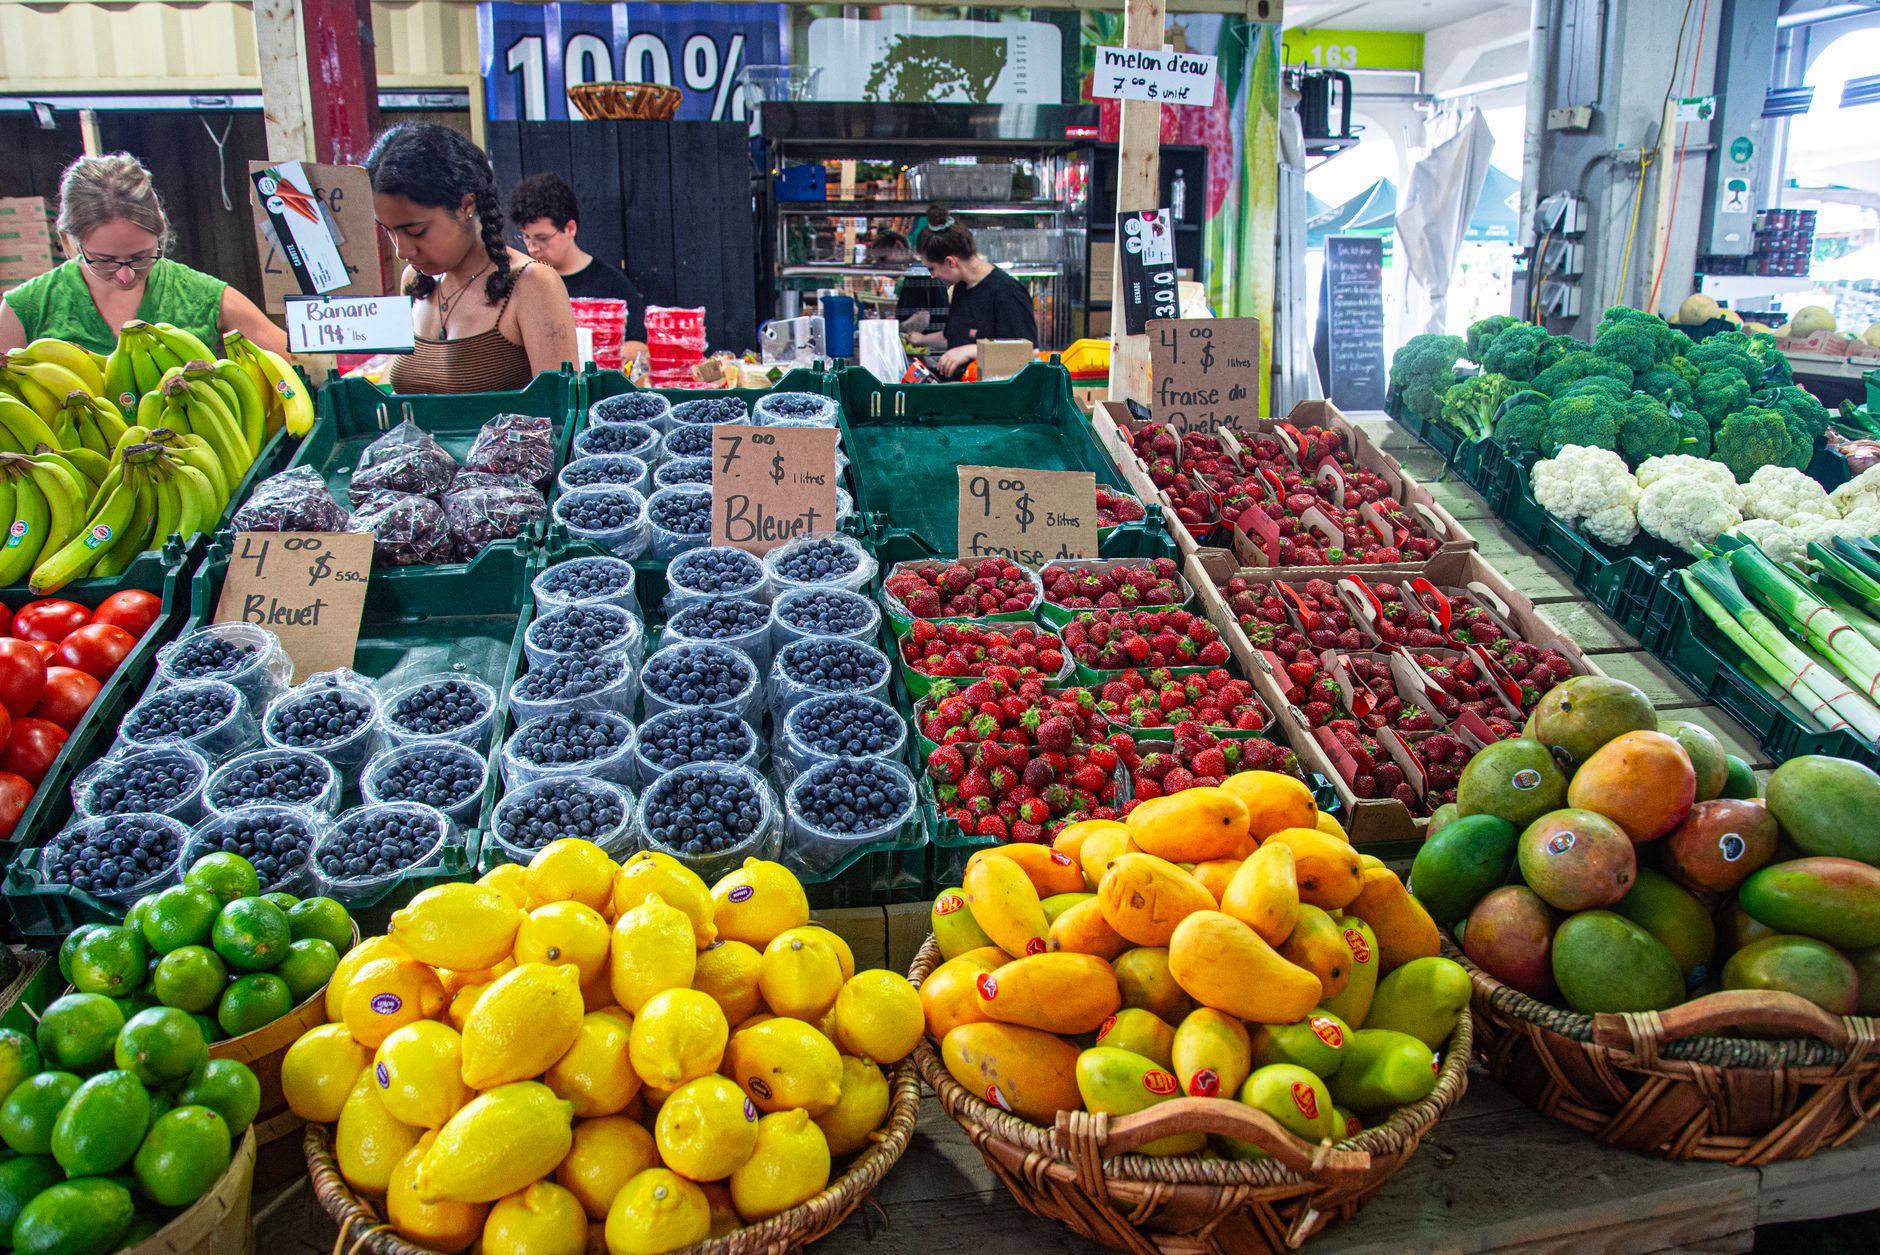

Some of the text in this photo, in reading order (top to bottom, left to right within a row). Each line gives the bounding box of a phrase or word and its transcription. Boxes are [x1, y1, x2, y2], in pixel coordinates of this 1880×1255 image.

[1105, 51, 1208, 76] melon d'eau
[1312, 45, 1357, 66] 163
[286, 244, 301, 267] CAROTTE
[1133, 282, 1141, 304] GRENADE
[307, 302, 377, 320] Banane
[352, 328, 367, 342] lbs
[1157, 377, 1247, 407] fraise du
[725, 495, 822, 543] Bleuet
[242, 594, 329, 626] Bleuet
